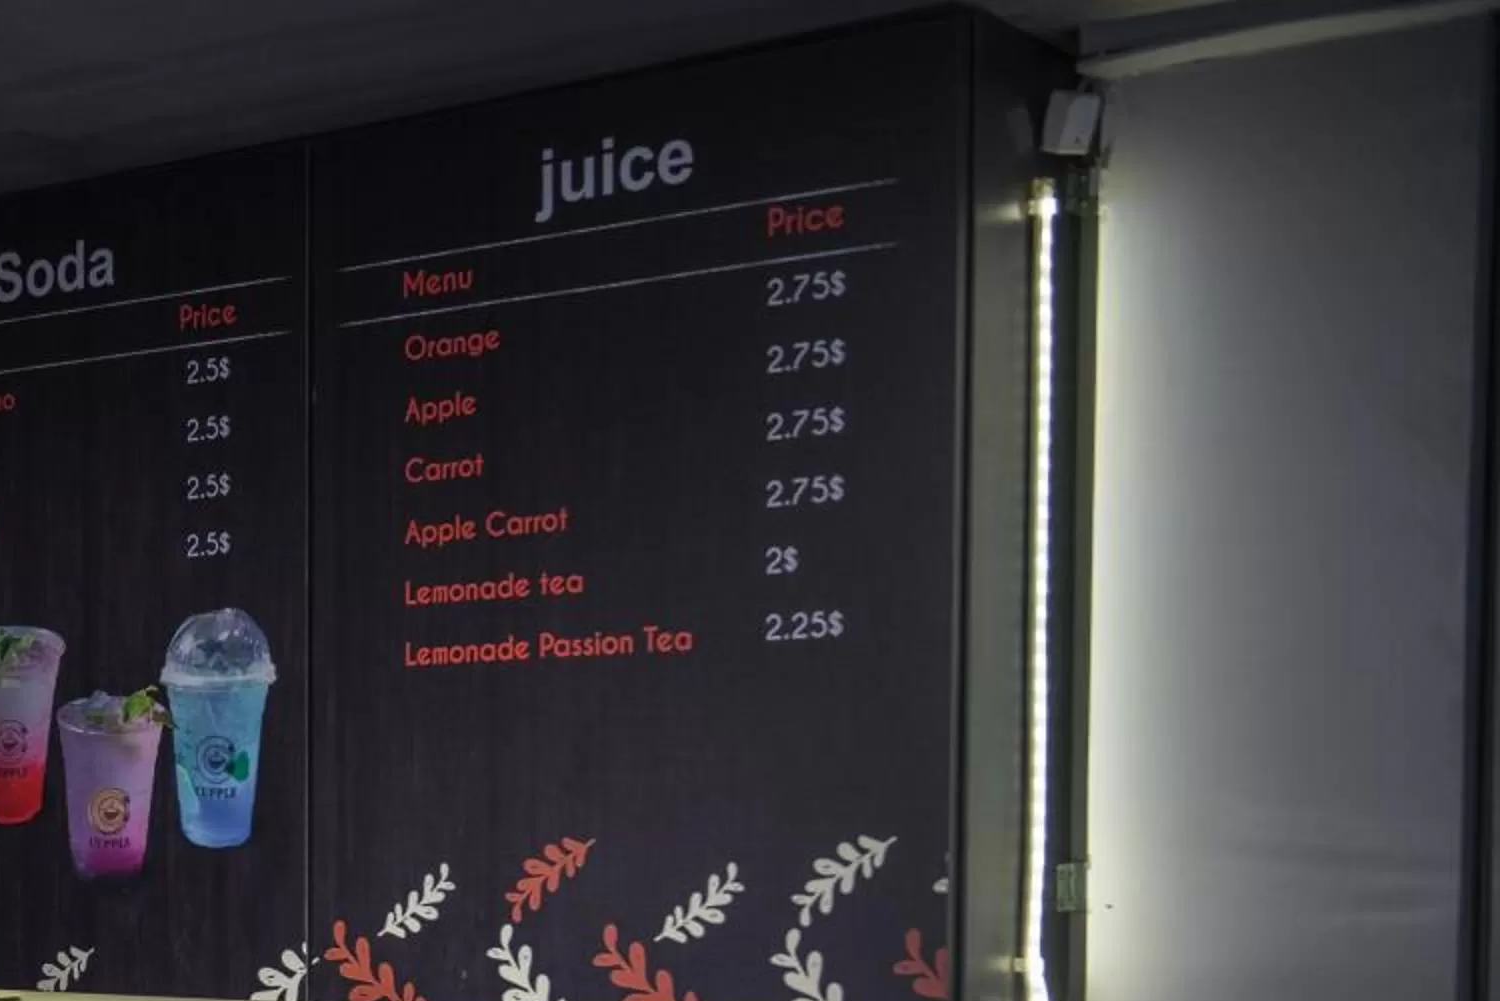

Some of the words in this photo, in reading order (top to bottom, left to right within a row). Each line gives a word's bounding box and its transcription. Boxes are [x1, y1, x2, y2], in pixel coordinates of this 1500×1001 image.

[535, 136, 695, 223] juice
[766, 204, 846, 237] Price
[402, 268, 474, 298] Menu
[765, 270, 847, 306] 2.75$
[179, 302, 238, 331] Price
[404, 327, 501, 362] Orange
[765, 338, 847, 374] 2.75$
[186, 355, 232, 385] 2.5$
[404, 391, 478, 426] Apple
[765, 407, 846, 441] 2.75$
[186, 415, 232, 443] 2.5$
[404, 453, 485, 485] Carrot
[186, 473, 232, 501] 2.5$
[765, 475, 846, 509] 2.75$
[186, 531, 232, 558] 2.5$
[404, 515, 476, 549] Apple
[485, 508, 569, 540] Carrot
[765, 546, 799, 575] 2$
[404, 573, 531, 606] Lemonade
[539, 570, 585, 595] tea
[765, 610, 846, 642] 2.25$
[404, 635, 531, 668] Lemonade
[538, 629, 635, 659] Passion
[645, 625, 693, 652] Tea
